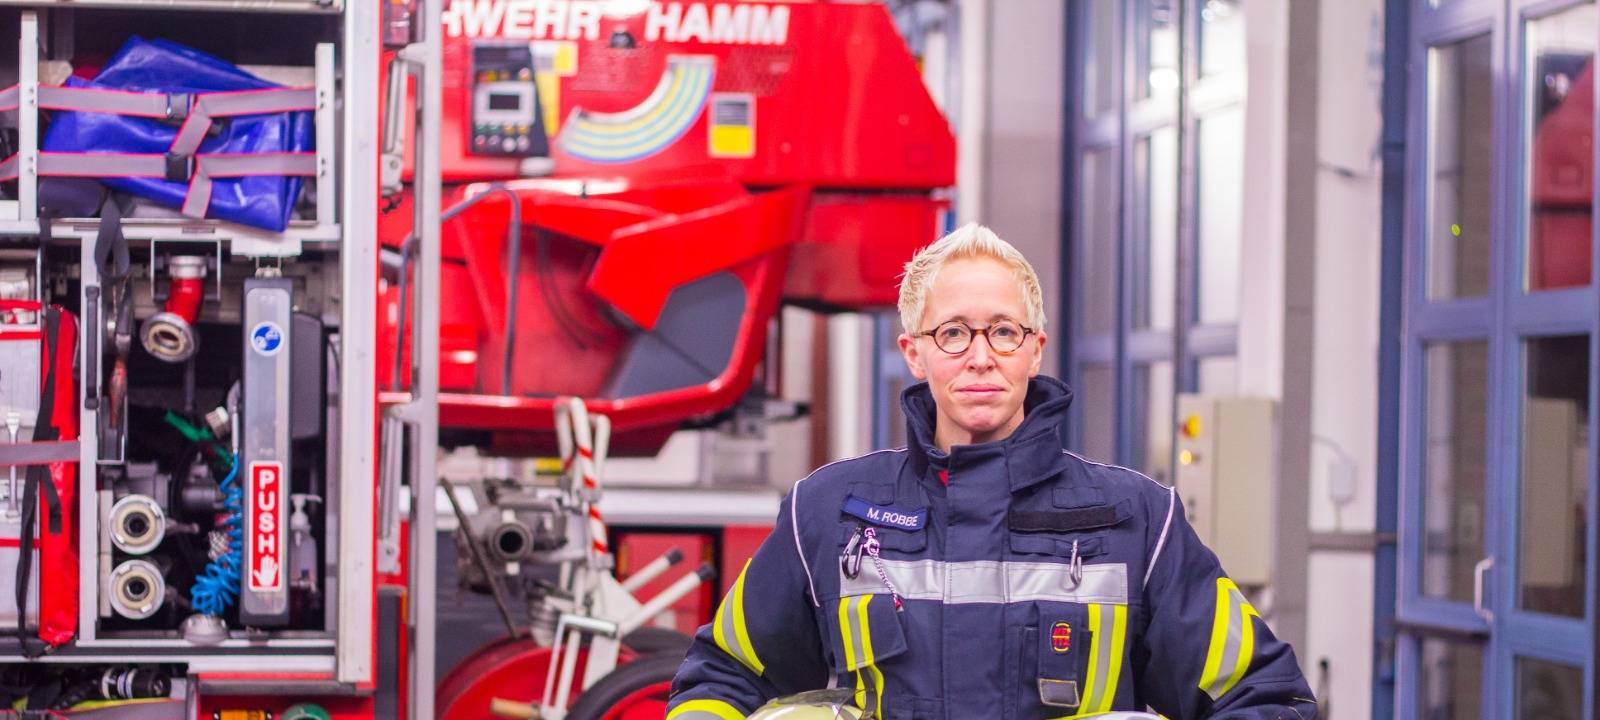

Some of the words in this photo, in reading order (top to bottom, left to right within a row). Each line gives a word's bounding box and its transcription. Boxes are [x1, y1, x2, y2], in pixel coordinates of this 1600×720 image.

[645, 3, 790, 45] HAMM
[258, 469, 275, 554] PUSH
[867, 507, 880, 520] M.
[882, 511, 919, 527] ROBBE
